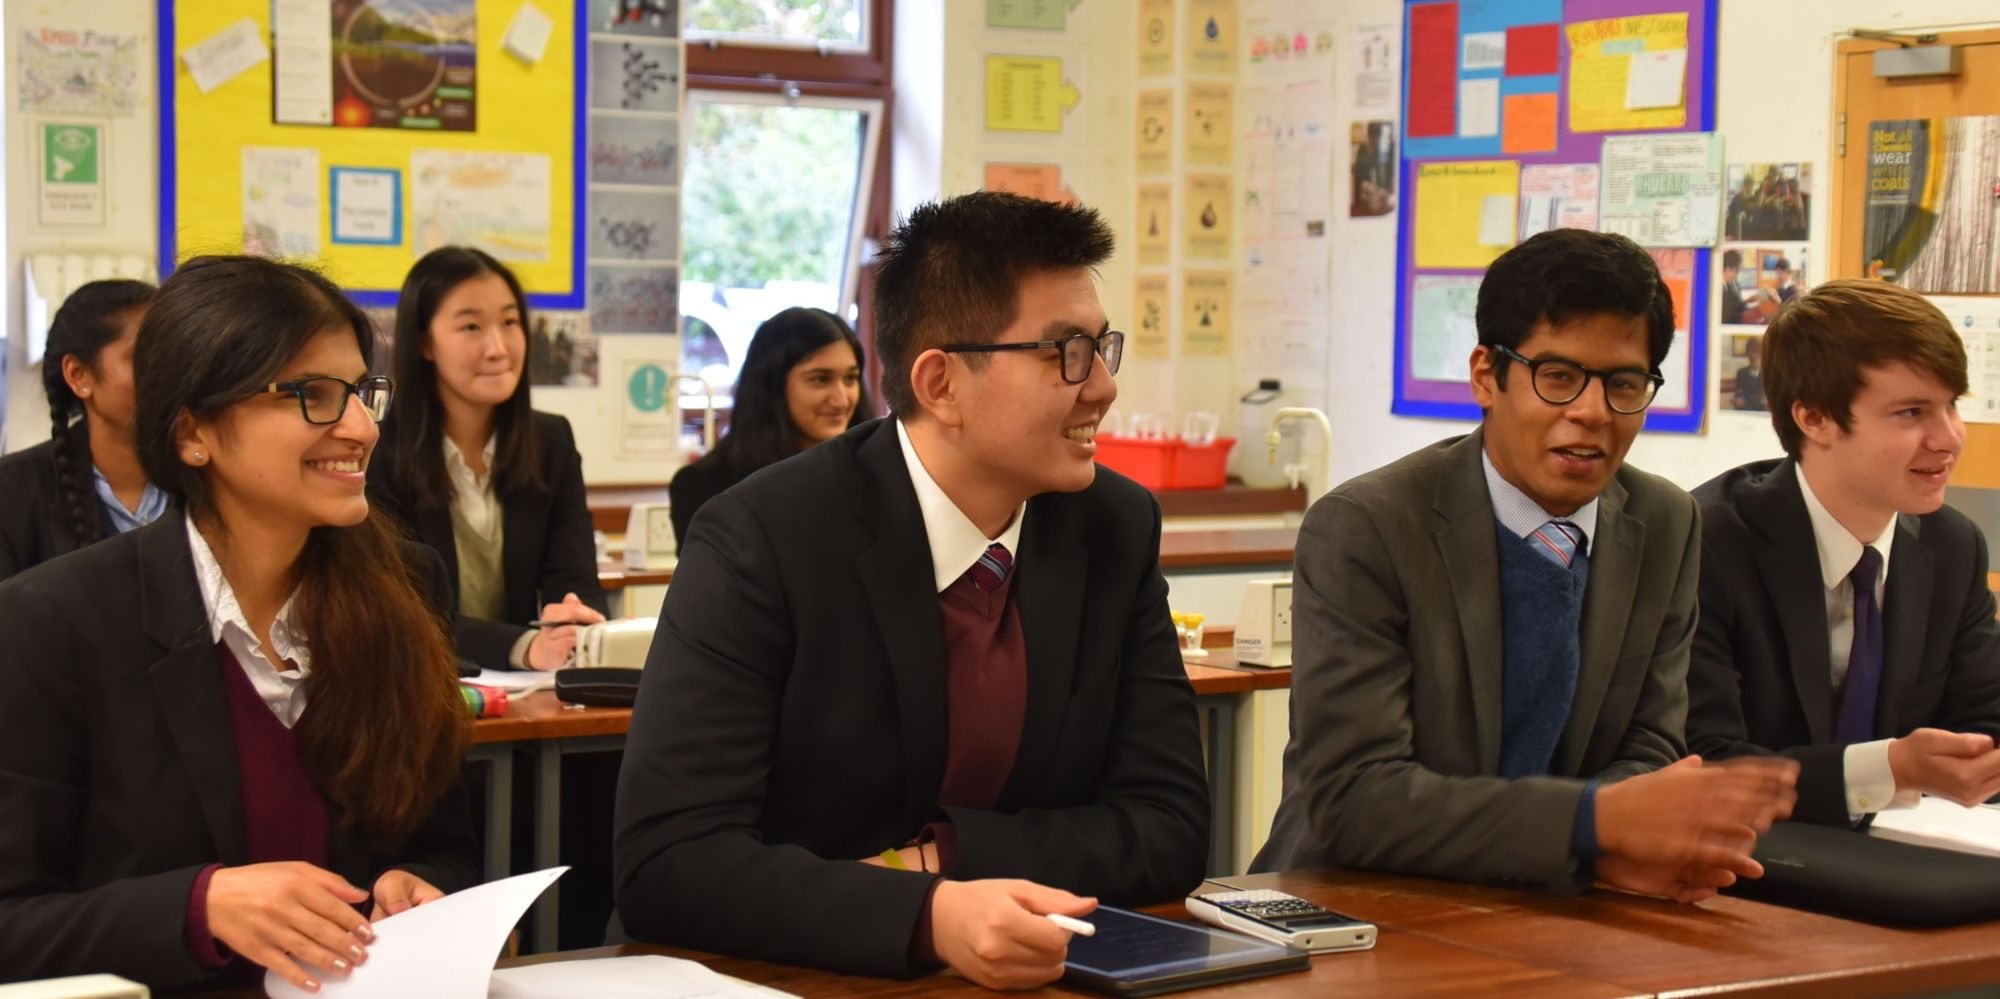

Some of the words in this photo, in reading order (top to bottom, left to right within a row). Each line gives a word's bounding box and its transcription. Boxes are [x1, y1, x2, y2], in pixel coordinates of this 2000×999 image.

[1874, 130, 1896, 143] Not
[1900, 128, 1913, 142] all
[1873, 152, 1912, 165] wear
[1872, 165, 1912, 177] white
[1871, 177, 1911, 190] coats
